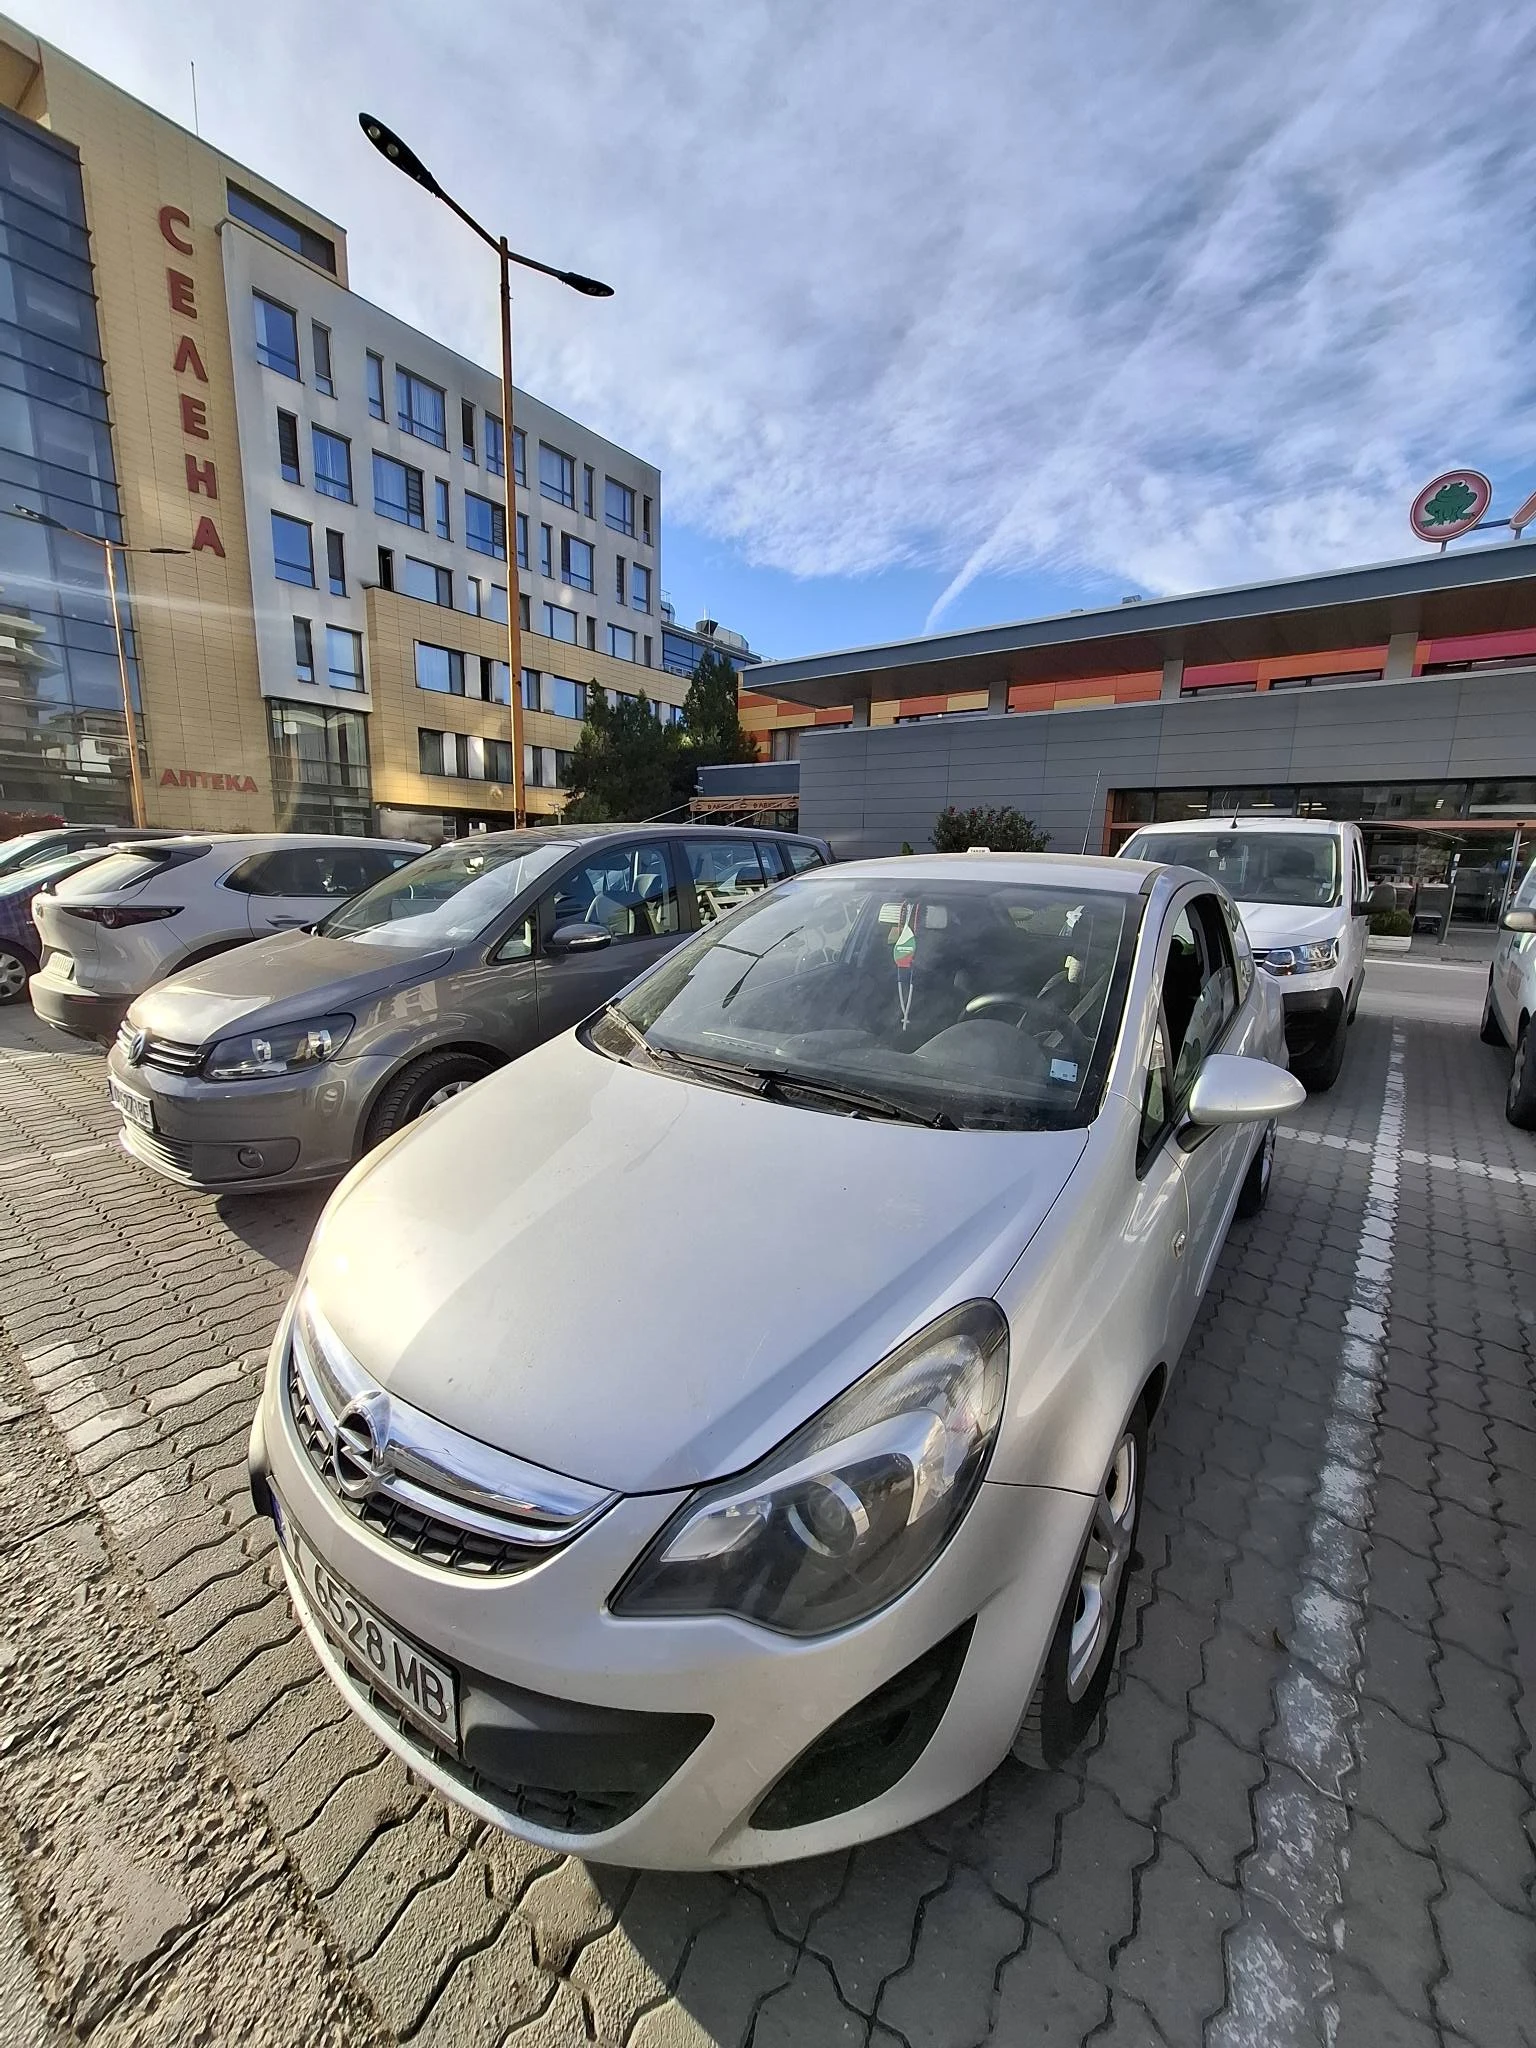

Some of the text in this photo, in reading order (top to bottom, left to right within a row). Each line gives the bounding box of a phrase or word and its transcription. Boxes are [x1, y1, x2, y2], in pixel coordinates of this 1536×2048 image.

[159, 205, 226, 559] СЕЛЕНА
[160, 768, 259, 793] АПТЕКА
[314, 1562, 386, 1673] 6528
[393, 1640, 448, 1724] MB
